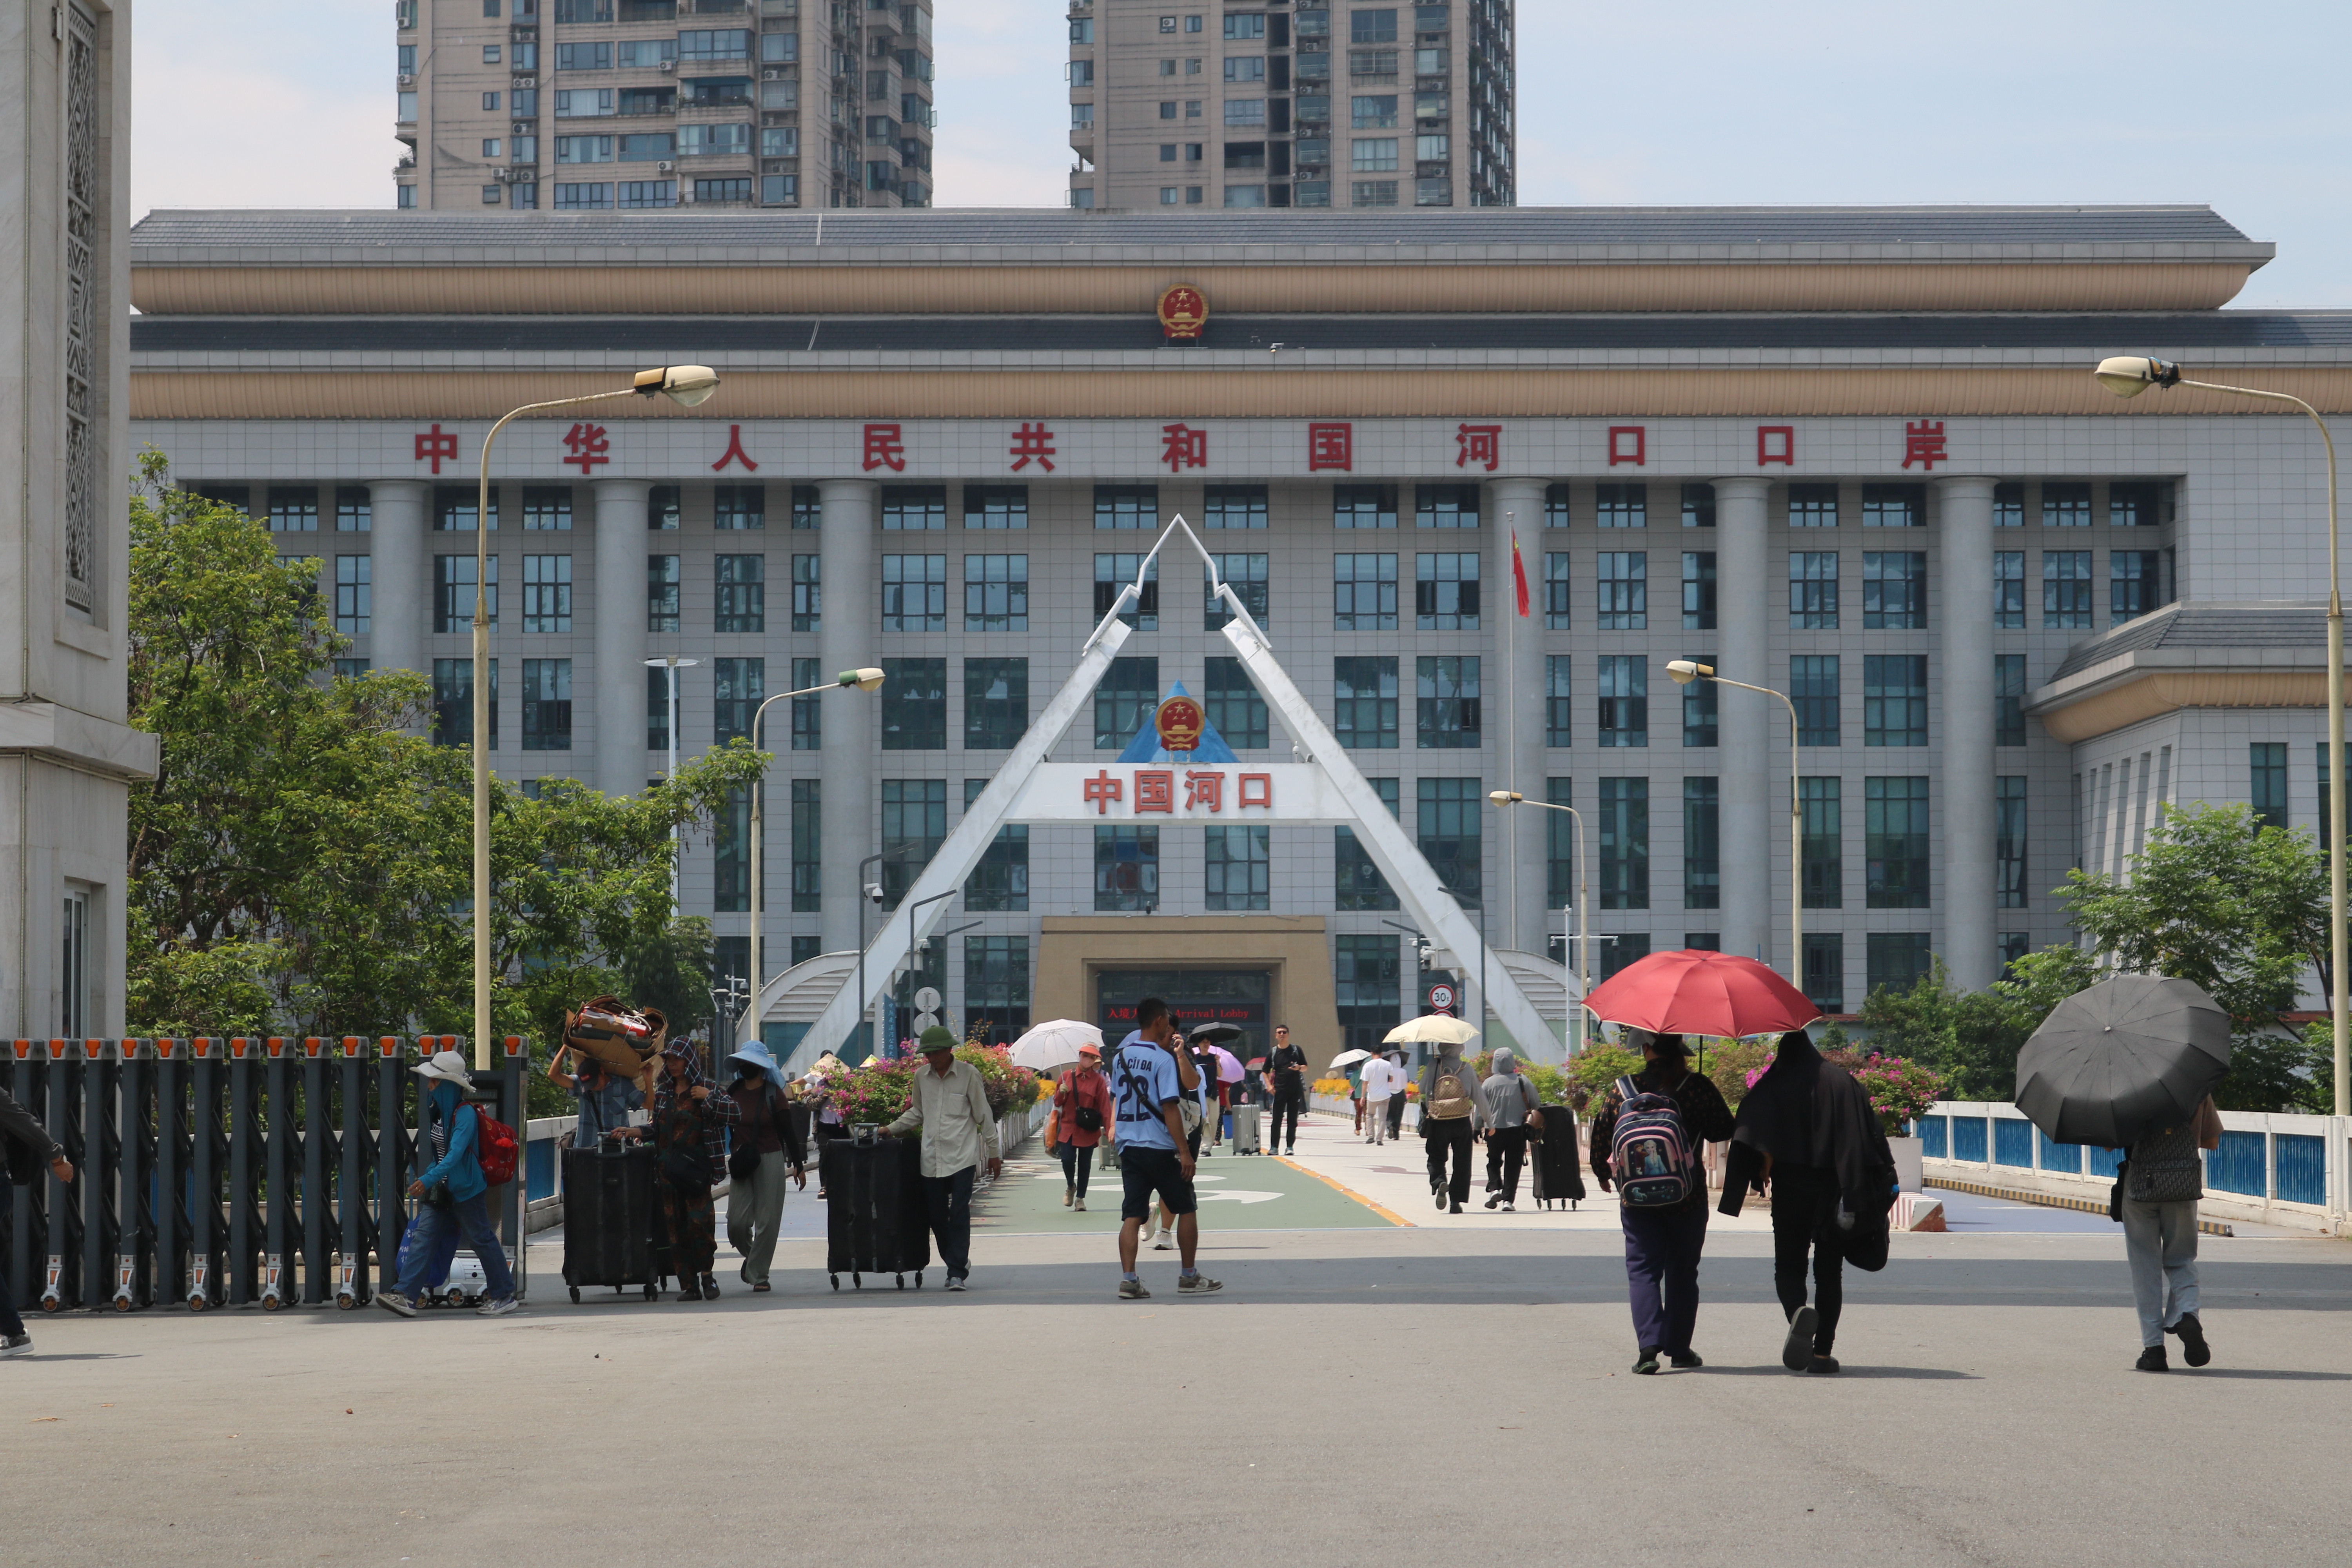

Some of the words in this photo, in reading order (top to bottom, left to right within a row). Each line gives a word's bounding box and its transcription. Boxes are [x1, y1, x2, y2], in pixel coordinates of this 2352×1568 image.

[415, 420, 1947, 474] 中华人民共和国河口口岸
[1084, 769, 1271, 814] 中国河口
[1176, 1009, 1214, 1018] Arrival
[1220, 1009, 1249, 1019] Lobby
